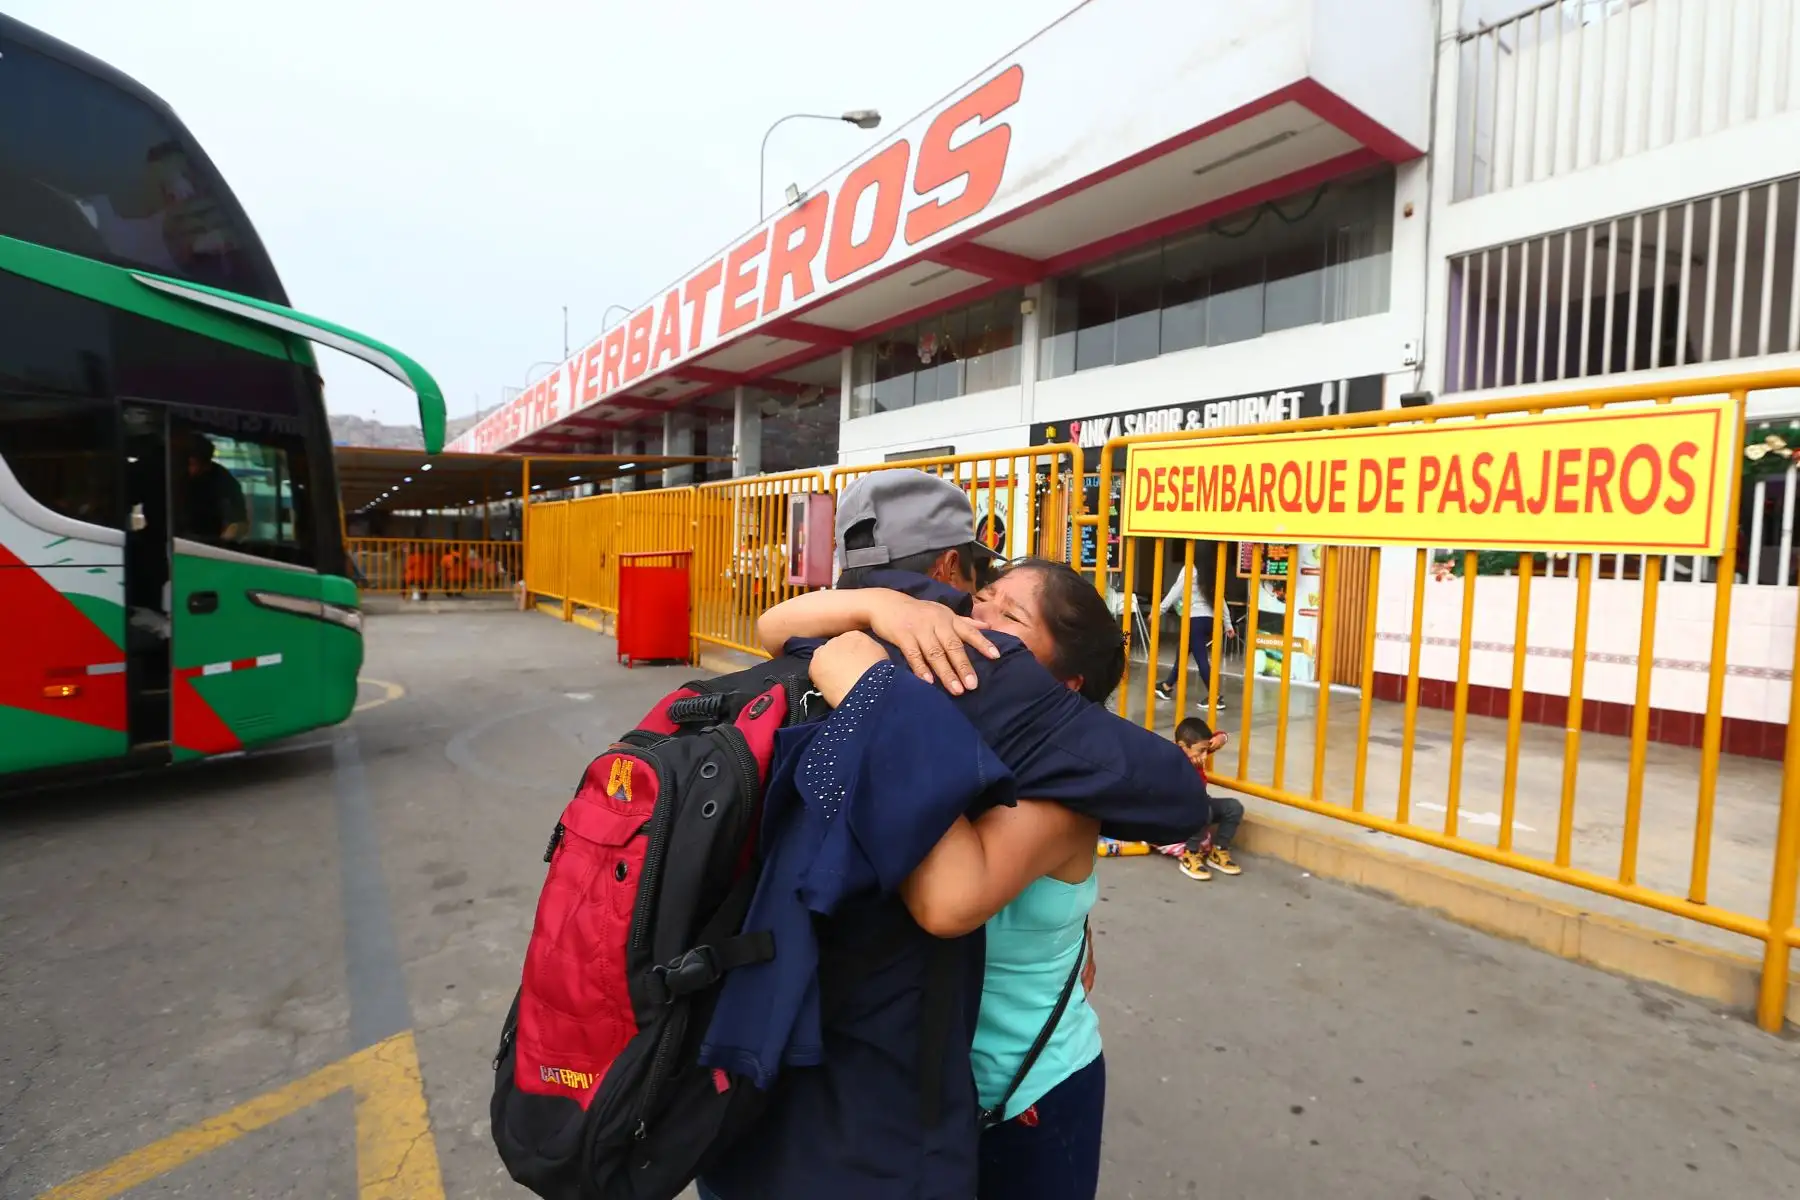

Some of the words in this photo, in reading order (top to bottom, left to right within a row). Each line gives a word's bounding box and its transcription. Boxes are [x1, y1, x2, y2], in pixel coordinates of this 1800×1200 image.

[567, 64, 1024, 411] YERBATEROS
[1124, 408, 1184, 437] SABOR
[1185, 410, 1203, 431] &
[1136, 459, 1348, 514] DESEMBARQUE
[1358, 457, 1406, 513] DE
[1417, 441, 1700, 515] PASAJEROS
